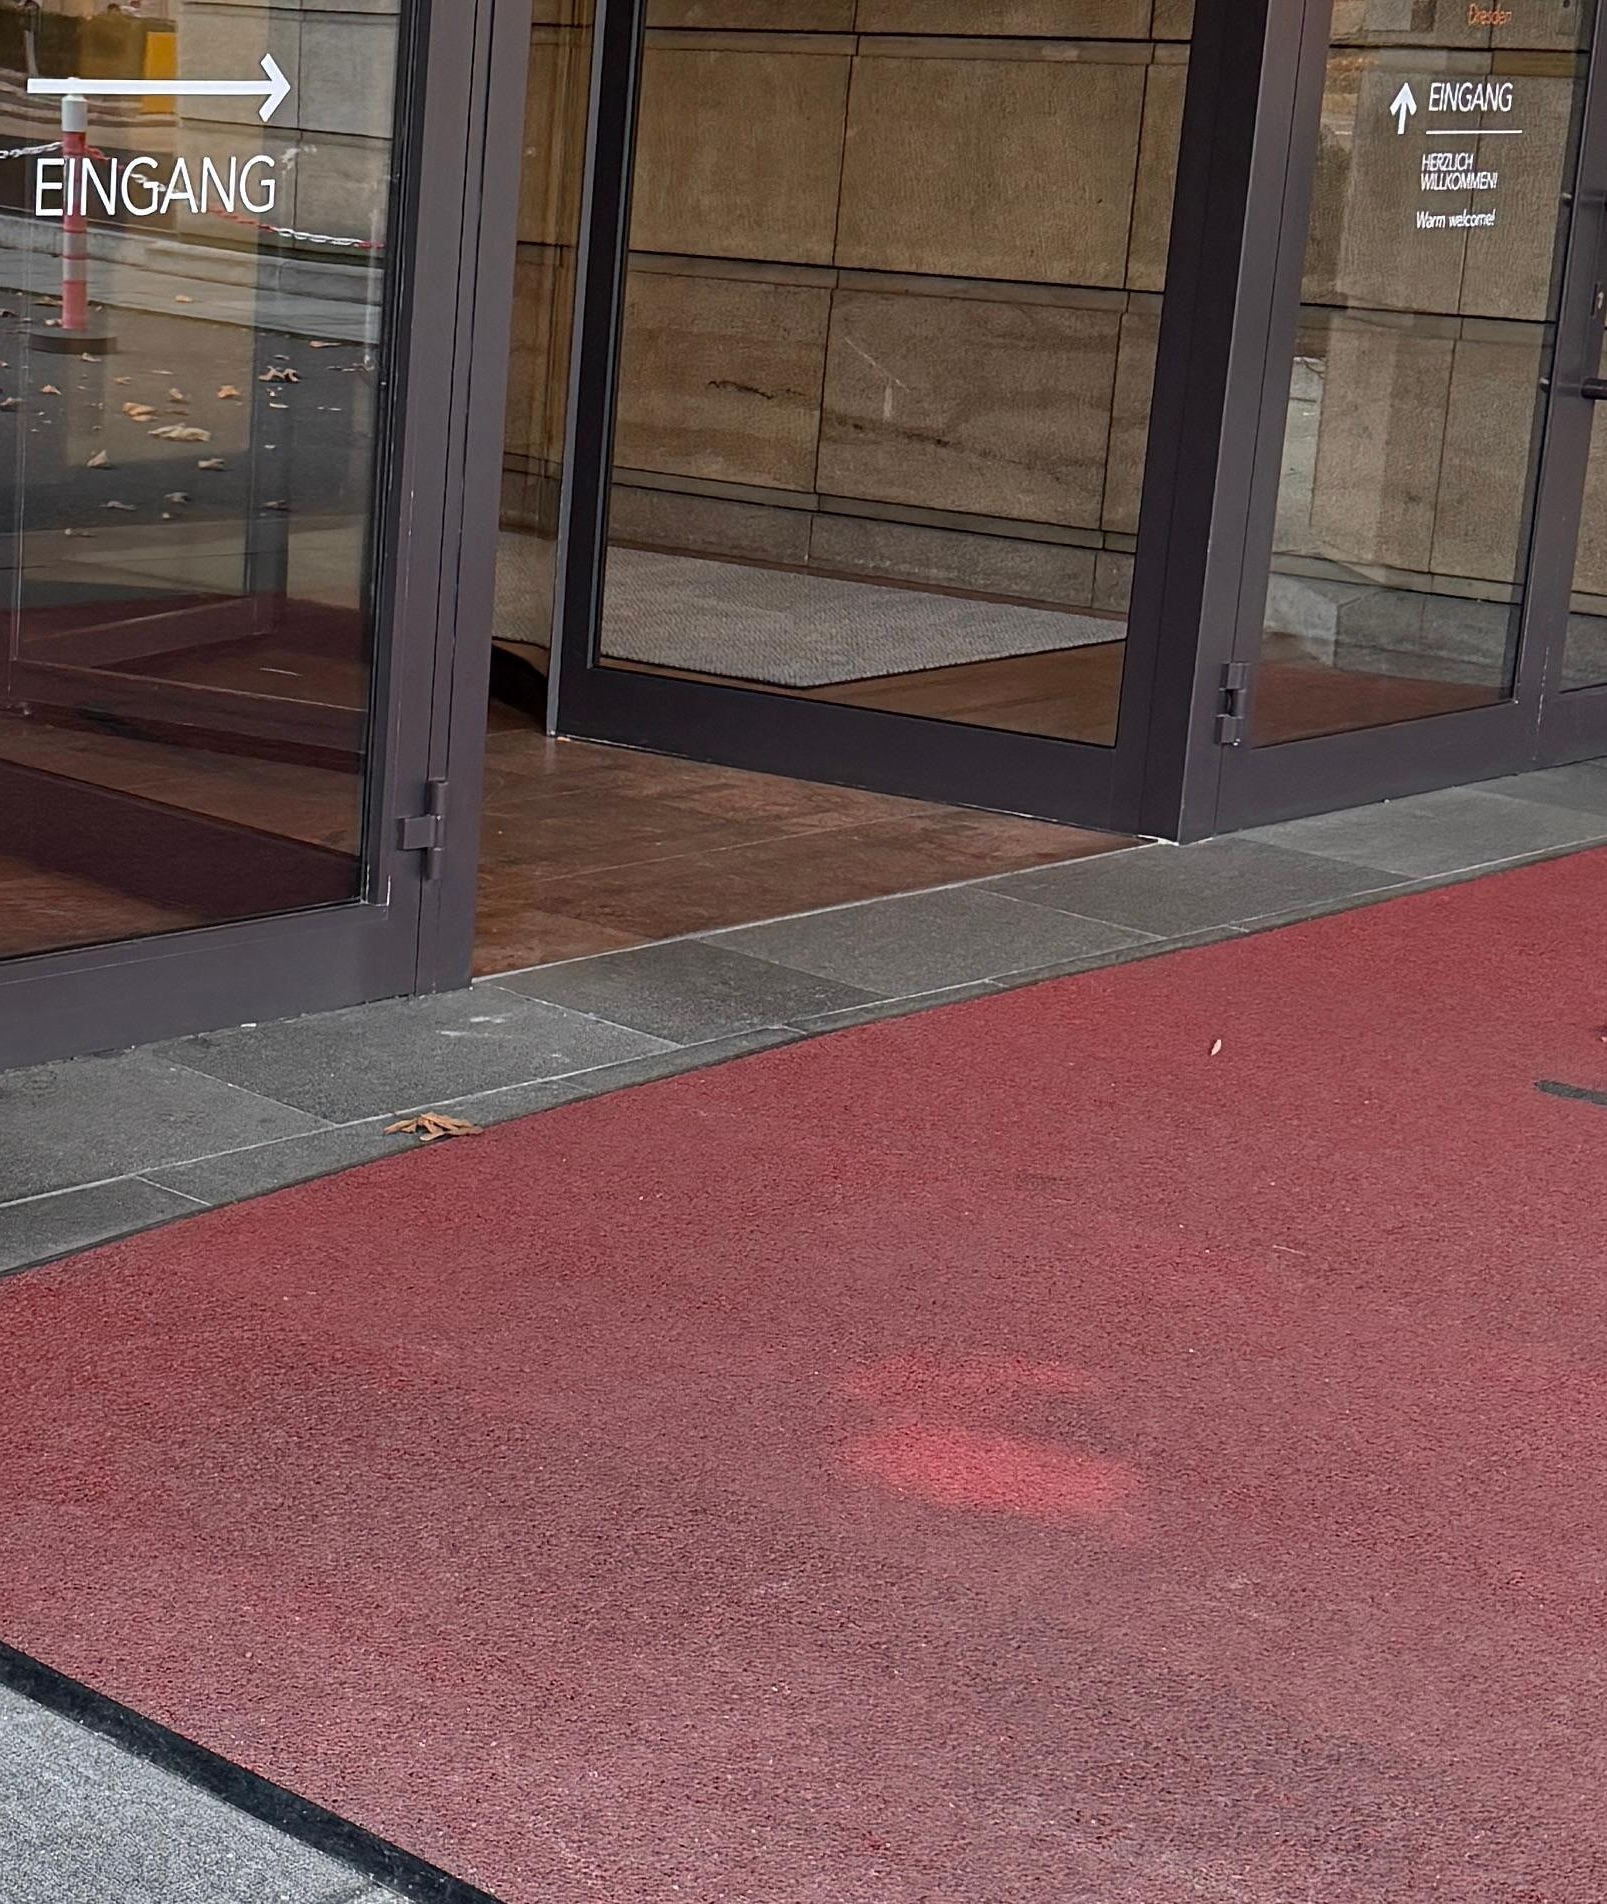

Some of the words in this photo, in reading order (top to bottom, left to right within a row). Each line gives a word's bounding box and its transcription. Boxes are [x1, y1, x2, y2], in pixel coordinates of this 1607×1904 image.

[1428, 82, 1514, 113] EINGANG
[1421, 152, 1475, 172] HERZLICH
[33, 154, 277, 218] EINGANG
[1420, 171, 1499, 192] WILLKOMMEN!
[1416, 210, 1446, 229] Warm
[1448, 208, 1497, 228] welcome!
